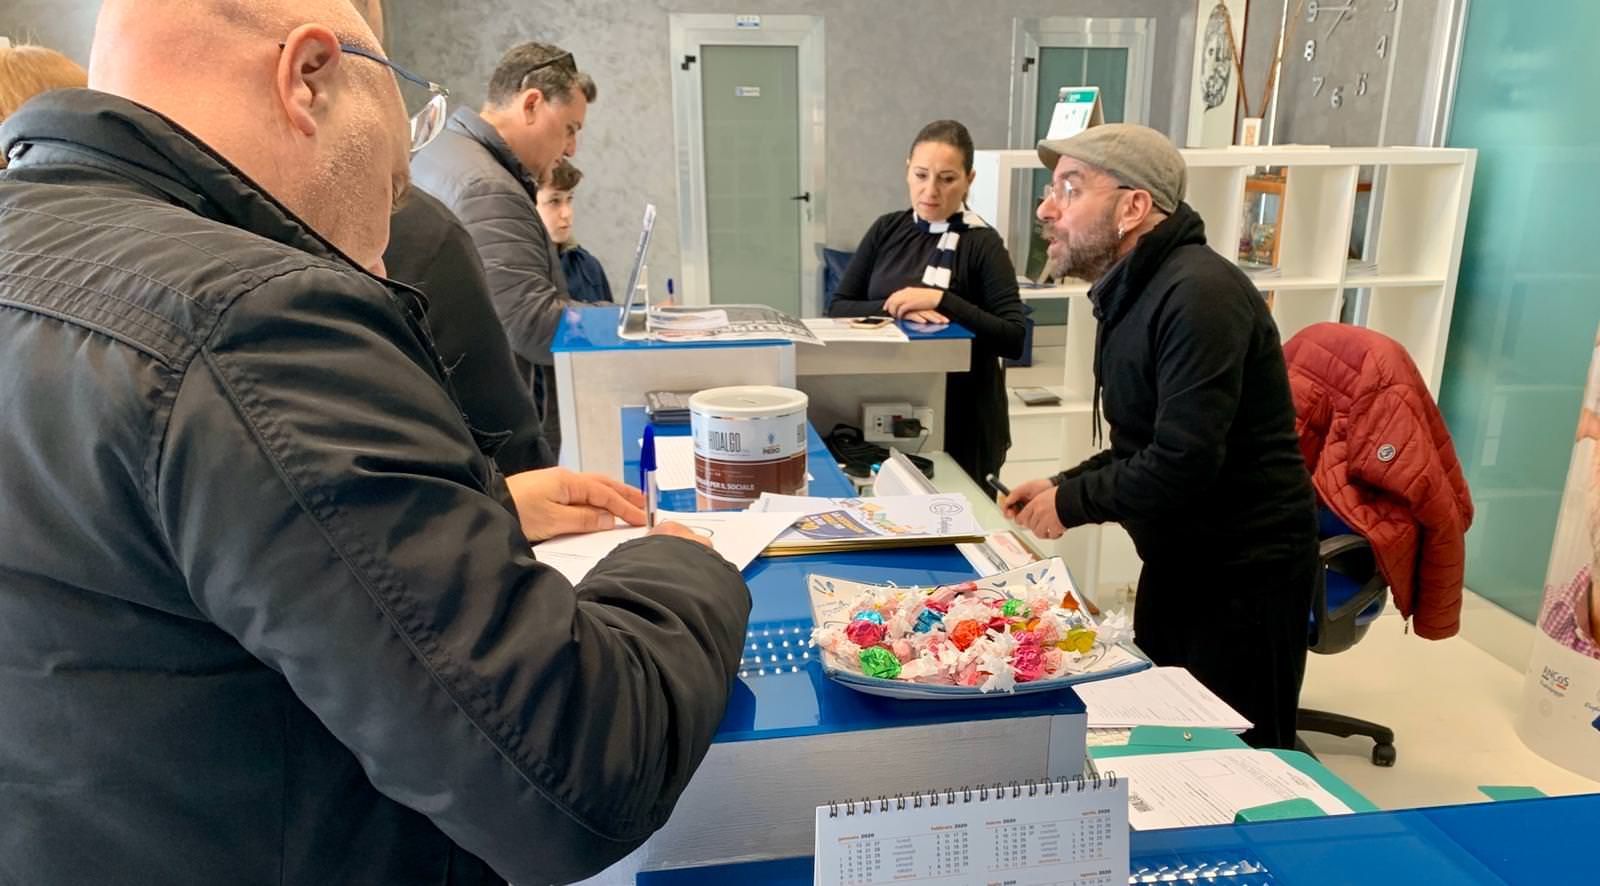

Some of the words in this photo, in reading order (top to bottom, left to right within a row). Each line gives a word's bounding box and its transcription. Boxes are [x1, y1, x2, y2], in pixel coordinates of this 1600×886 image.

[1307, 0, 1319, 22] 9
[1304, 40, 1316, 62] 8
[1376, 35, 1388, 59] 4
[1312, 76, 1325, 97] 7
[1354, 73, 1368, 96] 5
[1331, 86, 1344, 108] 6
